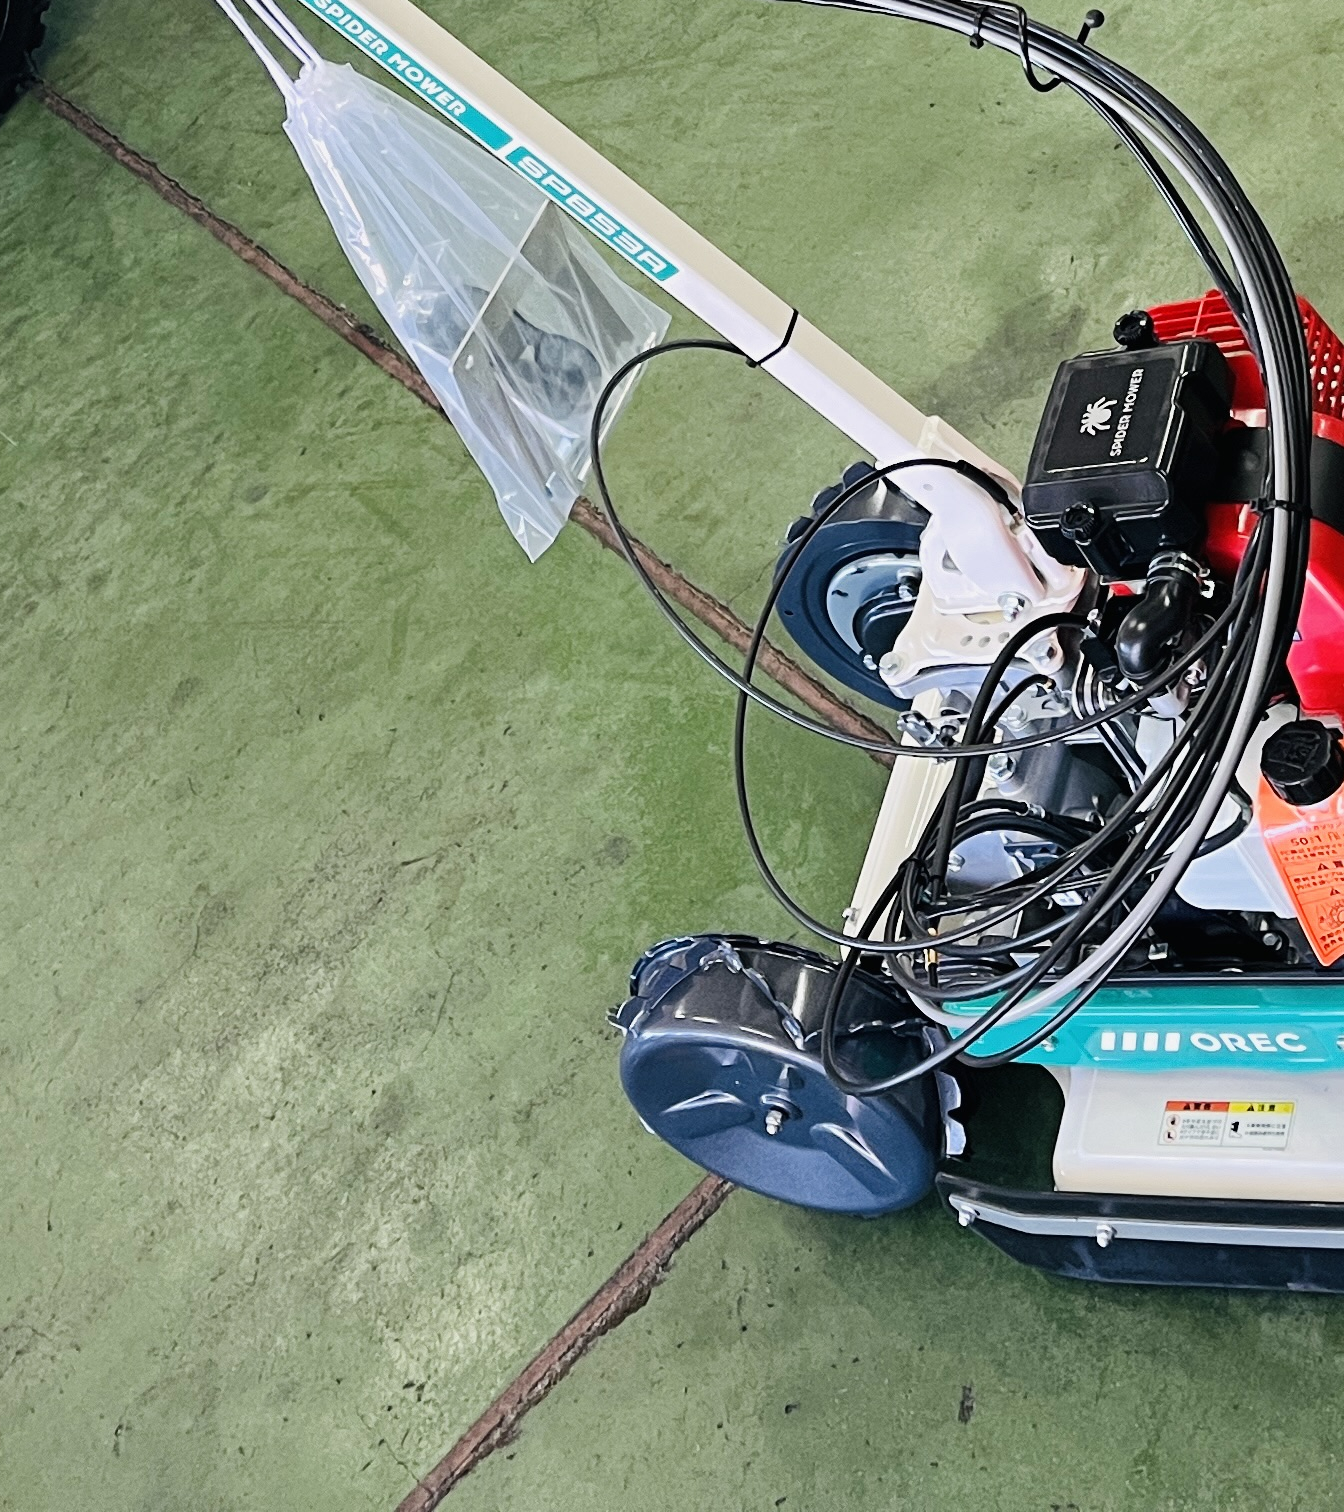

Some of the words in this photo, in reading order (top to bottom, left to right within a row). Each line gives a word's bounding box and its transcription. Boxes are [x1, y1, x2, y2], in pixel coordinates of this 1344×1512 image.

[387, 53, 467, 117] MOWER
[517, 155, 668, 274] SP853A
[1109, 414, 1132, 458] SPIDER
[1122, 368, 1145, 414] MOWER
[1189, 1031, 1308, 1053] OREC
